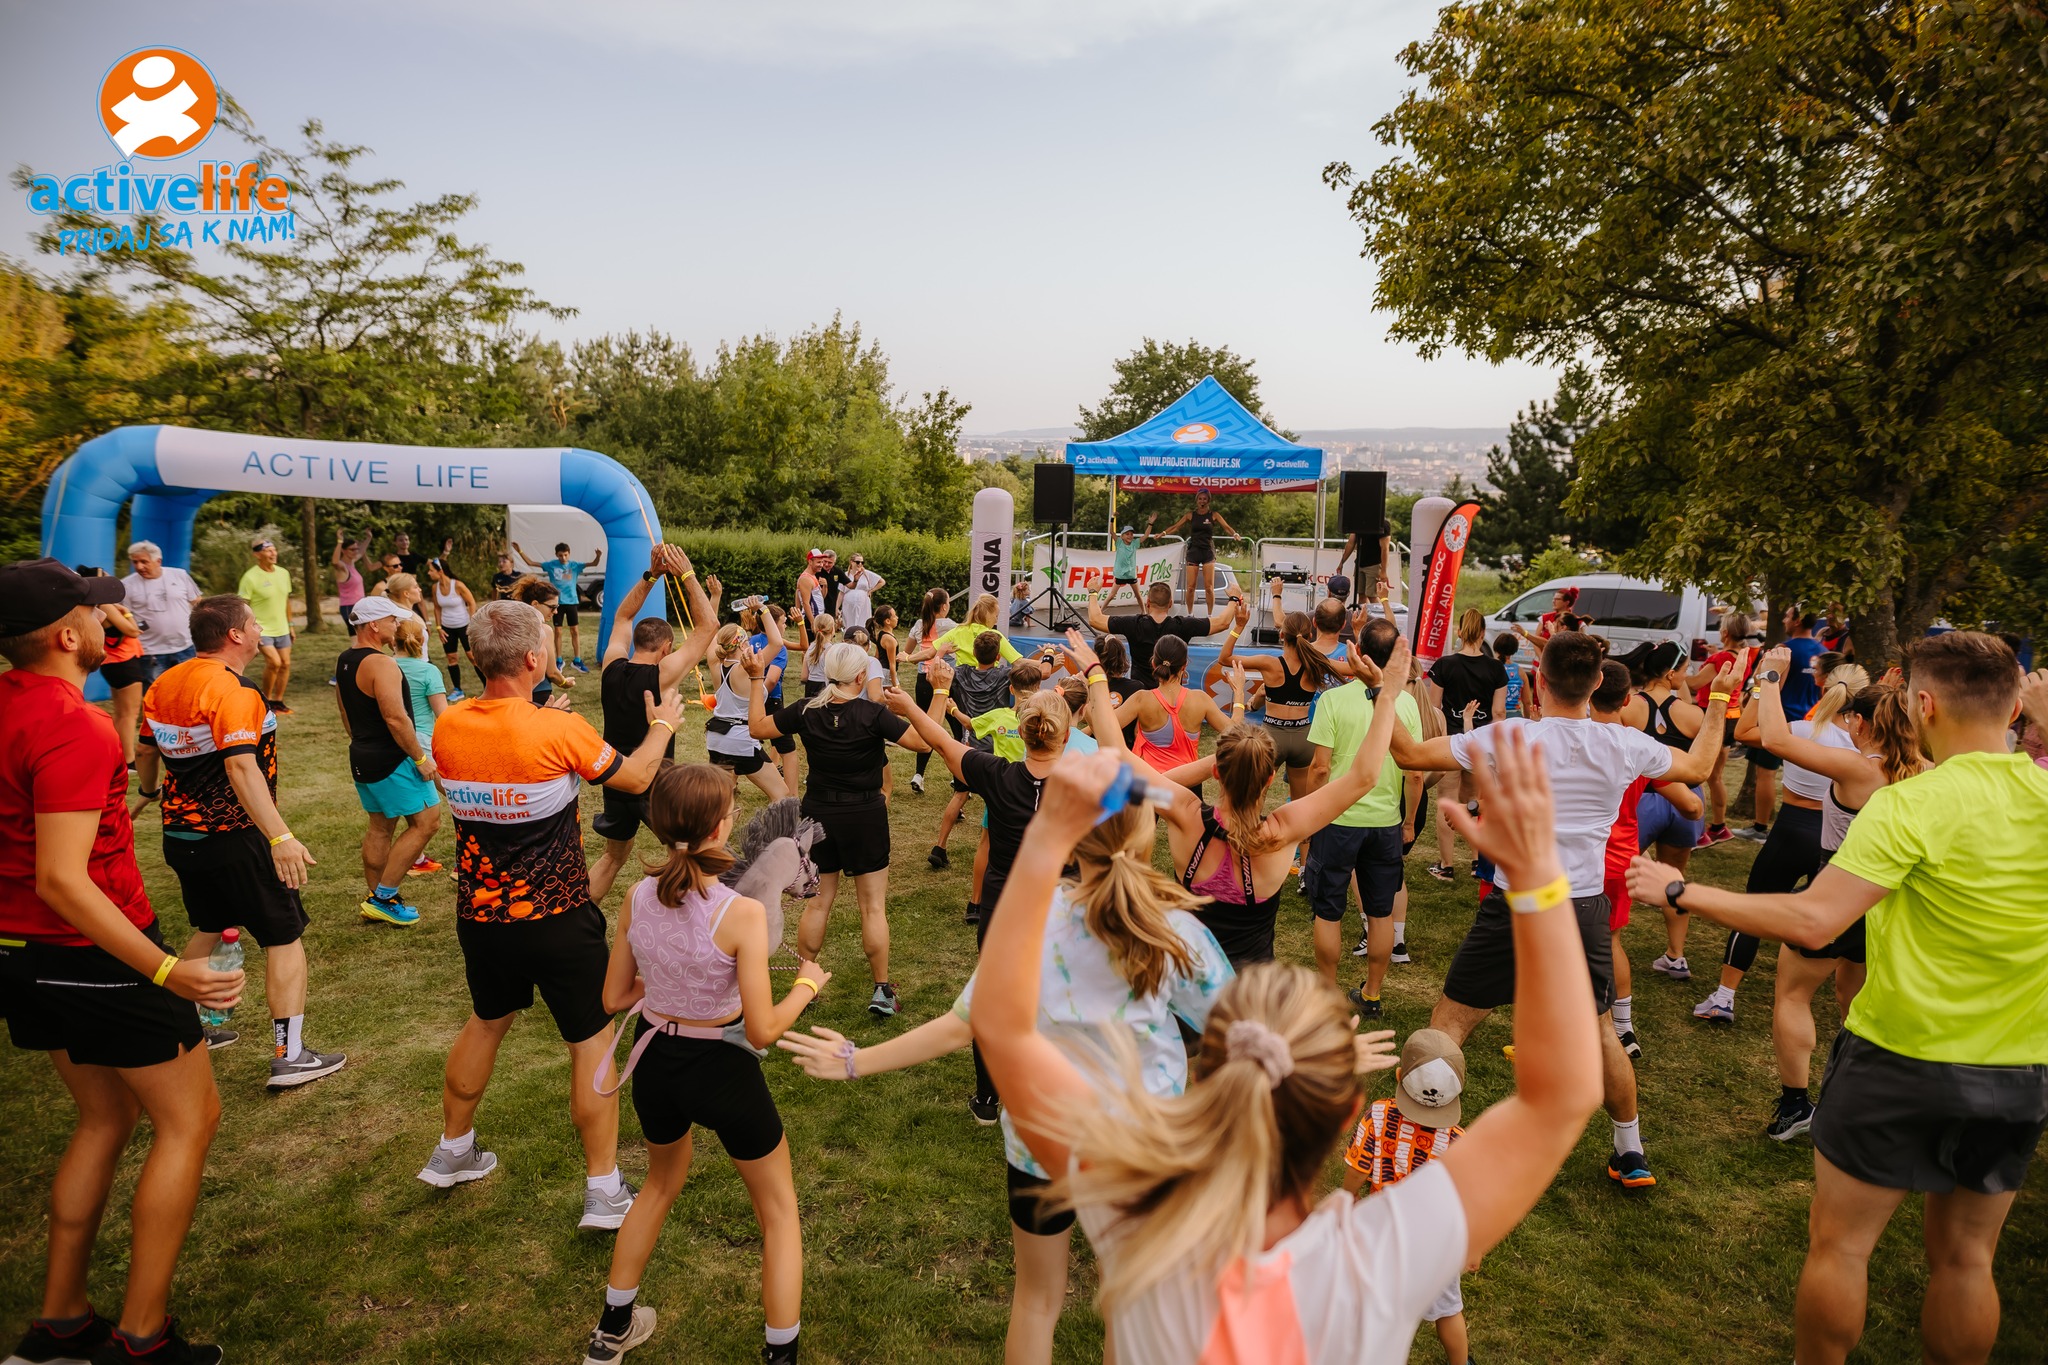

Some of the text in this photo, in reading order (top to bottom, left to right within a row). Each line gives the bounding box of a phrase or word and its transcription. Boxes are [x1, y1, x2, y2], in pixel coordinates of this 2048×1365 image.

[242, 451, 489, 489] ACTIVE LIFE
[1087, 456, 1119, 465] activelife
[1139, 456, 1241, 469] WWW.PROJEKTACTIVELIFE.SK
[1276, 459, 1310, 469] activelife
[982, 537, 1002, 598] GNA
[1067, 565, 1149, 588] FREH
[1427, 551, 1447, 605] POMOC
[1427, 611, 1446, 648] FIRST
[1439, 583, 1453, 610] AID
[1264, 716, 1284, 726] NIKE
[223, 729, 257, 743] active
[446, 783, 529, 807] activelife
[494, 809, 531, 821] team
[1399, 1123, 1415, 1140] TO
[1382, 1157, 1395, 1183] WIN
